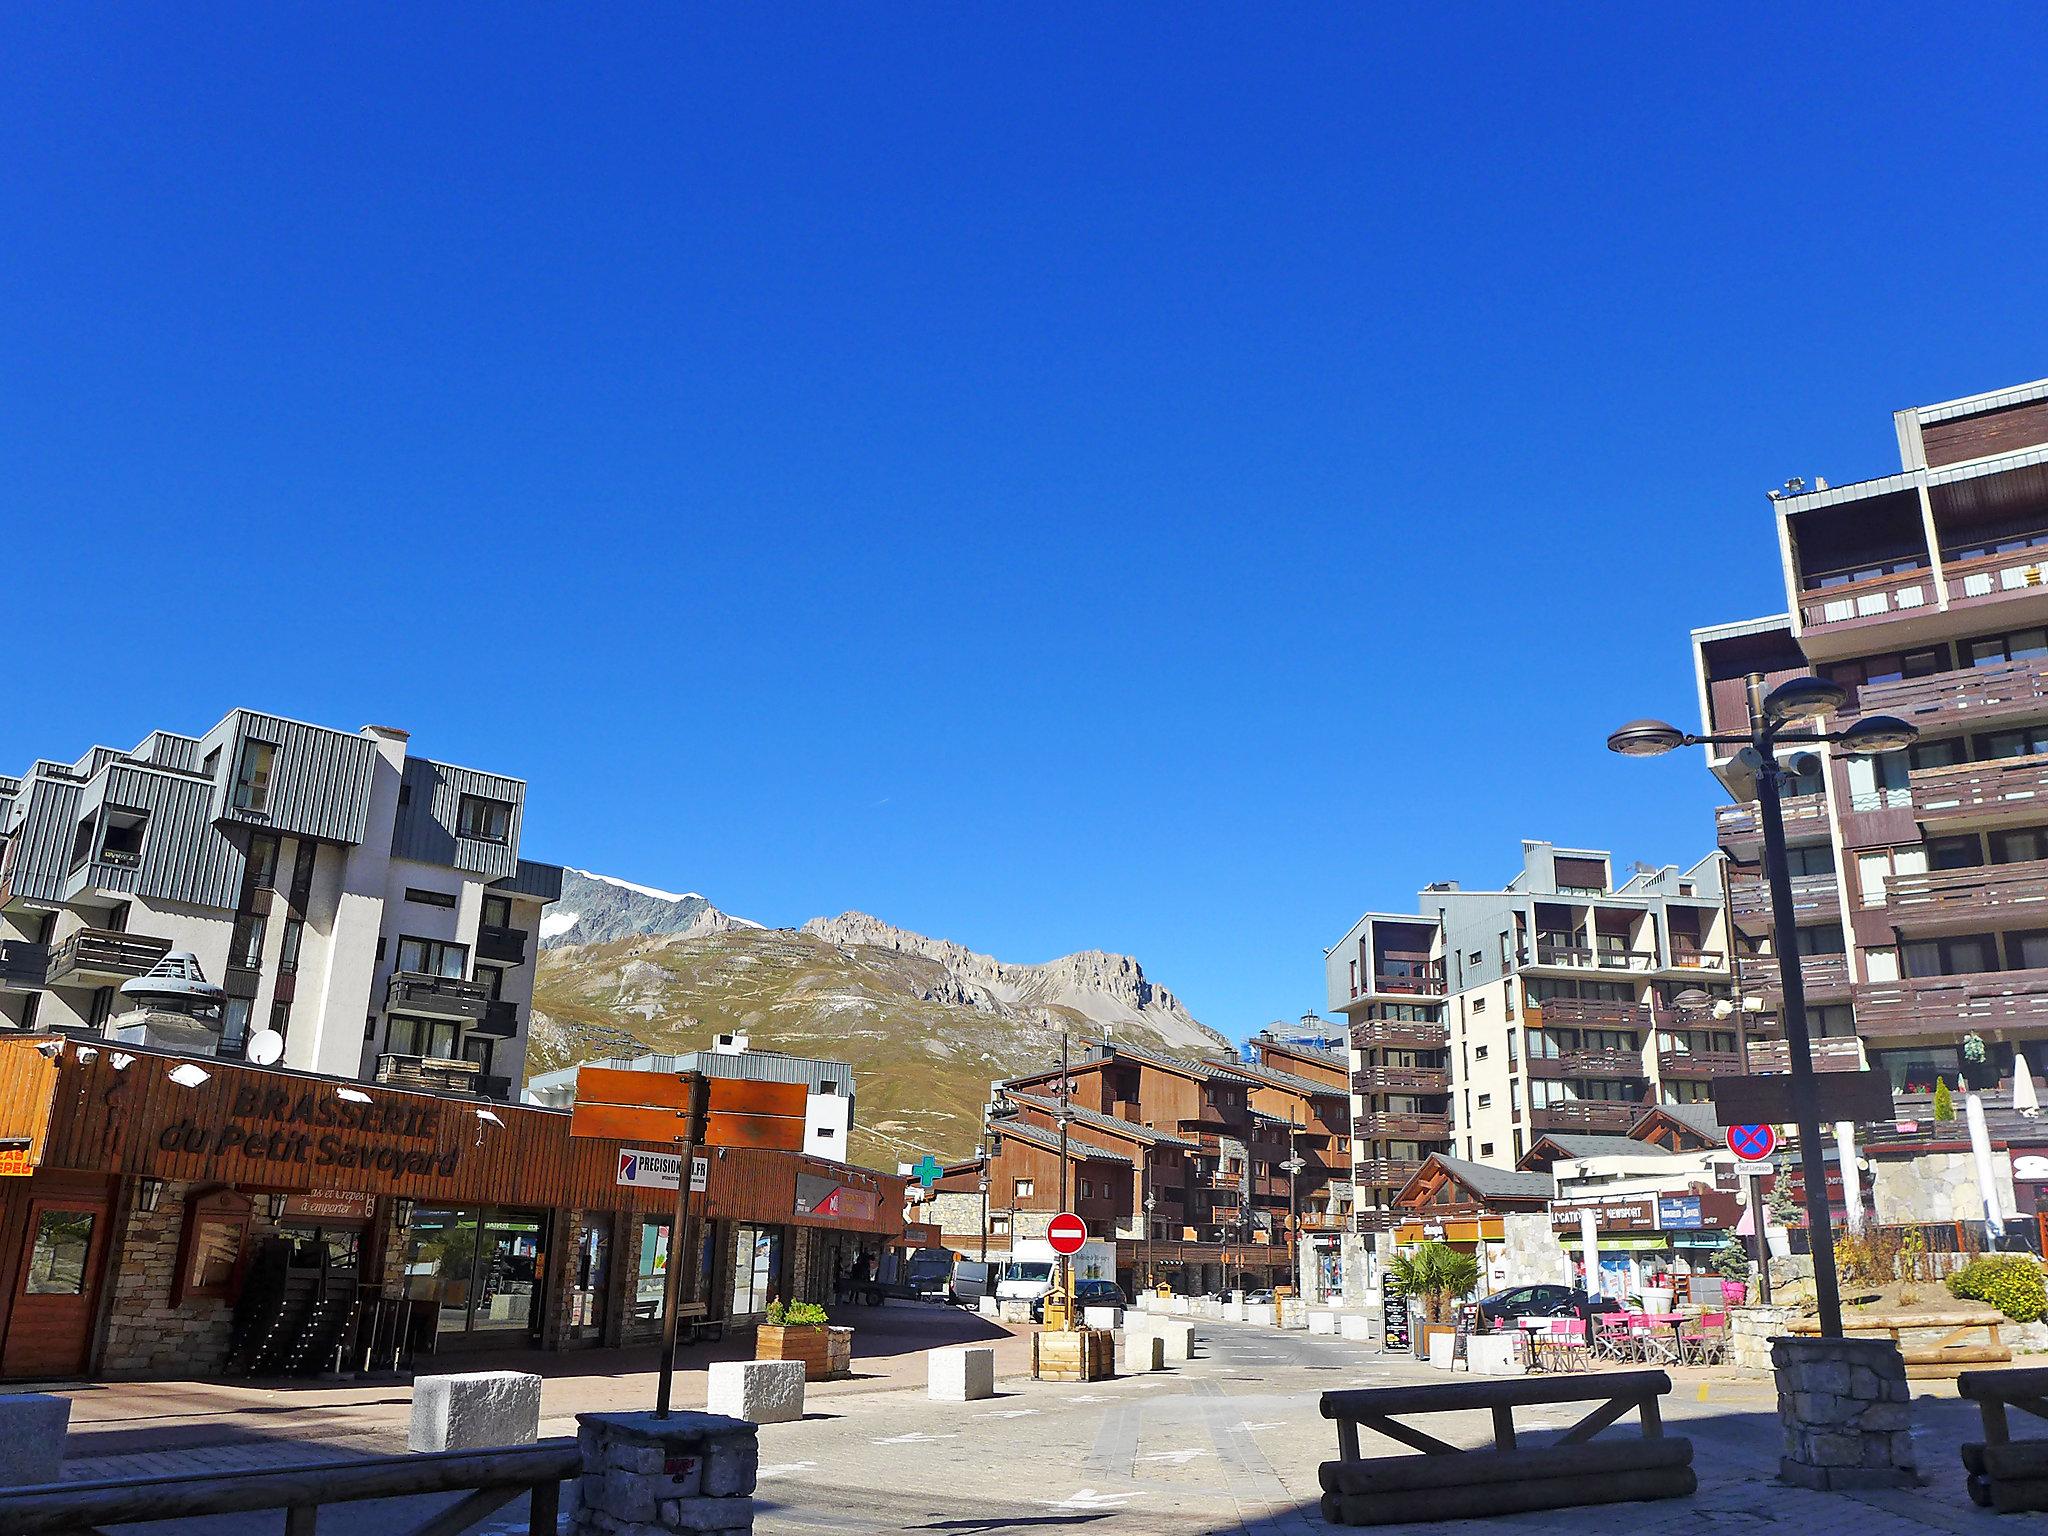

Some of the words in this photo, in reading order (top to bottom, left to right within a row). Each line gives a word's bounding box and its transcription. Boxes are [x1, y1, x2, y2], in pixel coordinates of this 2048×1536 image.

[234, 1087, 440, 1138] BRASSERIE
[159, 1118, 209, 1153] du
[214, 1125, 312, 1163] Petit
[316, 1134, 459, 1180] Savoyard
[310, 1203, 351, 1215] emporter
[1606, 1207, 1642, 1219] NEWSPORT
